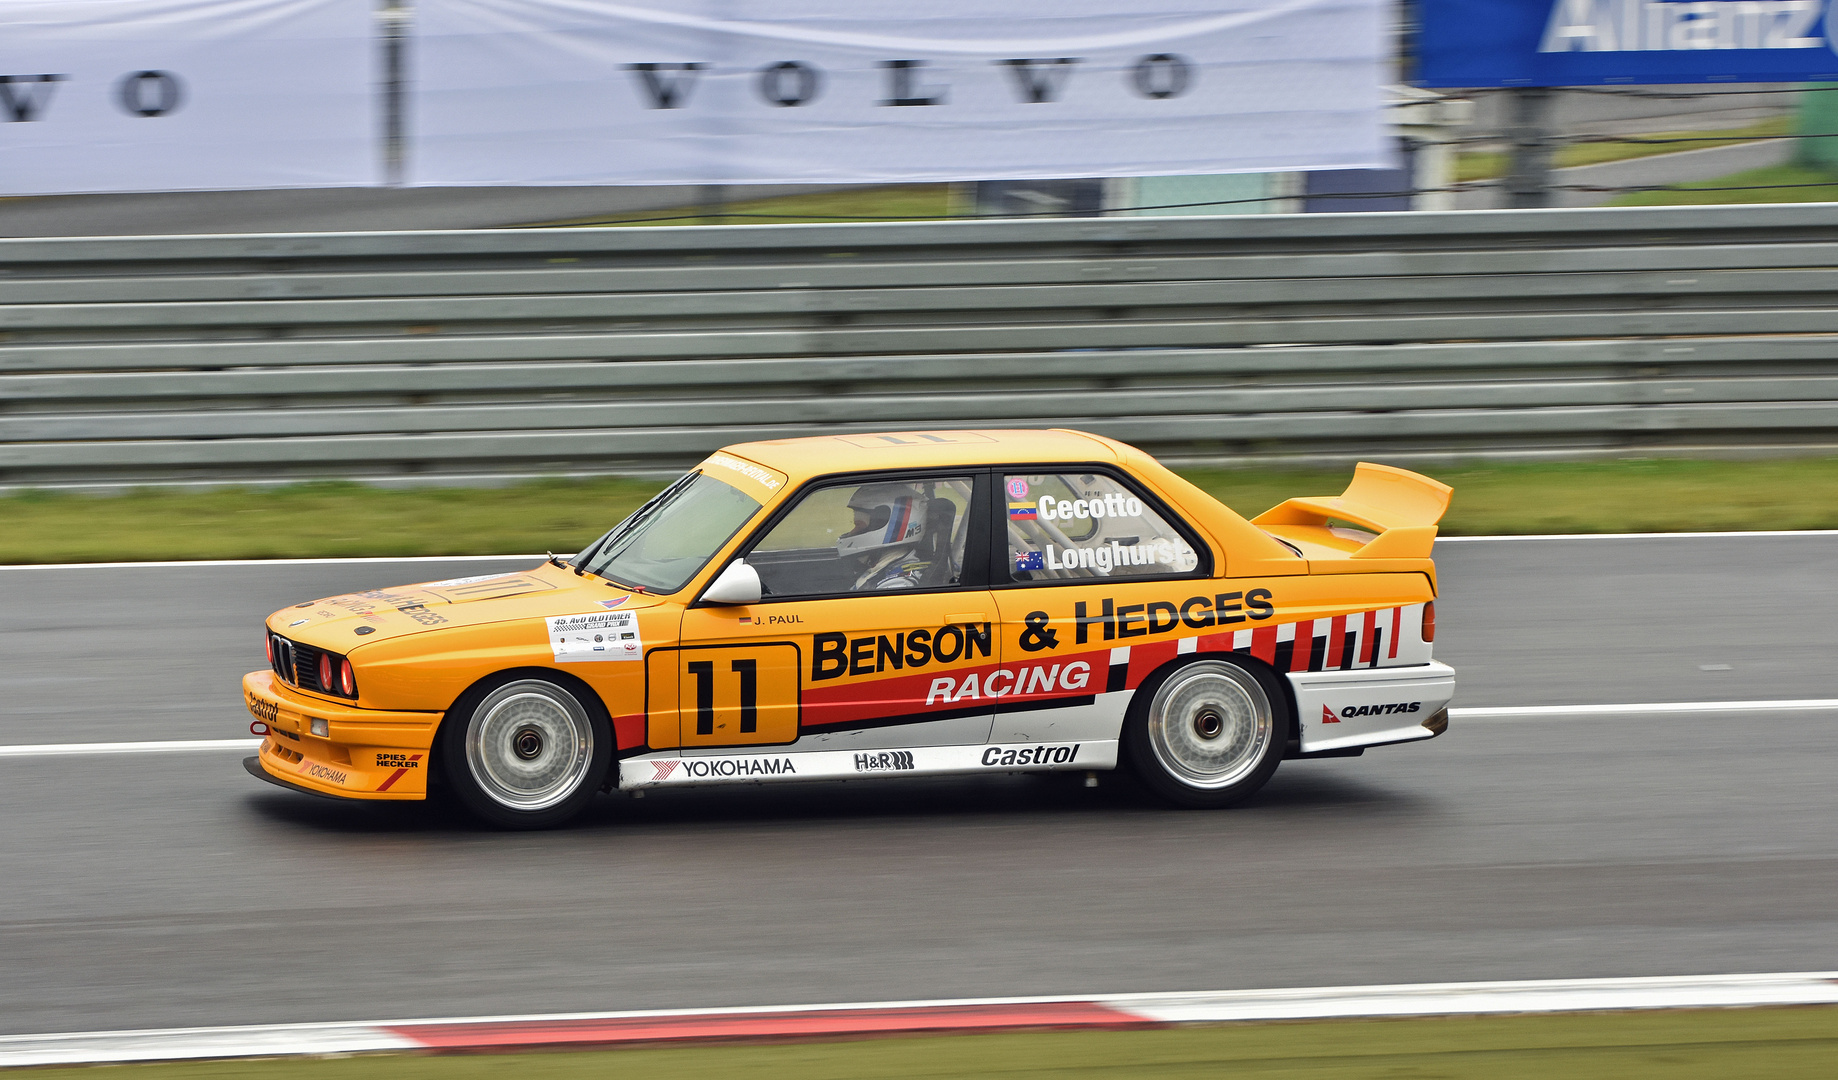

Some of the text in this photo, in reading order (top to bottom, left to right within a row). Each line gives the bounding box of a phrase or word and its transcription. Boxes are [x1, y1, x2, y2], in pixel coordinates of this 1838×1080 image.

[1538, 0, 1824, 53] Allianz
[617, 53, 1194, 109] VOLVO
[1039, 492, 1143, 520] Cecotto
[905, 524, 921, 539] M3
[1046, 538, 1184, 573] Longhurst
[570, 616, 586, 624] AvD
[588, 613, 631, 622] OLDTIMER
[755, 614, 804, 625] J. PAUL
[812, 588, 1274, 682] BENSON & HEDGES
[926, 660, 1091, 706] RACING
[688, 659, 757, 735] 11
[1341, 701, 1421, 718] QANTAS
[376, 760, 419, 768] HECKER
[854, 752, 893, 771] H&R
[981, 744, 1080, 767] Castrol
[309, 763, 348, 785] YOKOHAMA
[682, 758, 796, 777] YOKOHAMA
